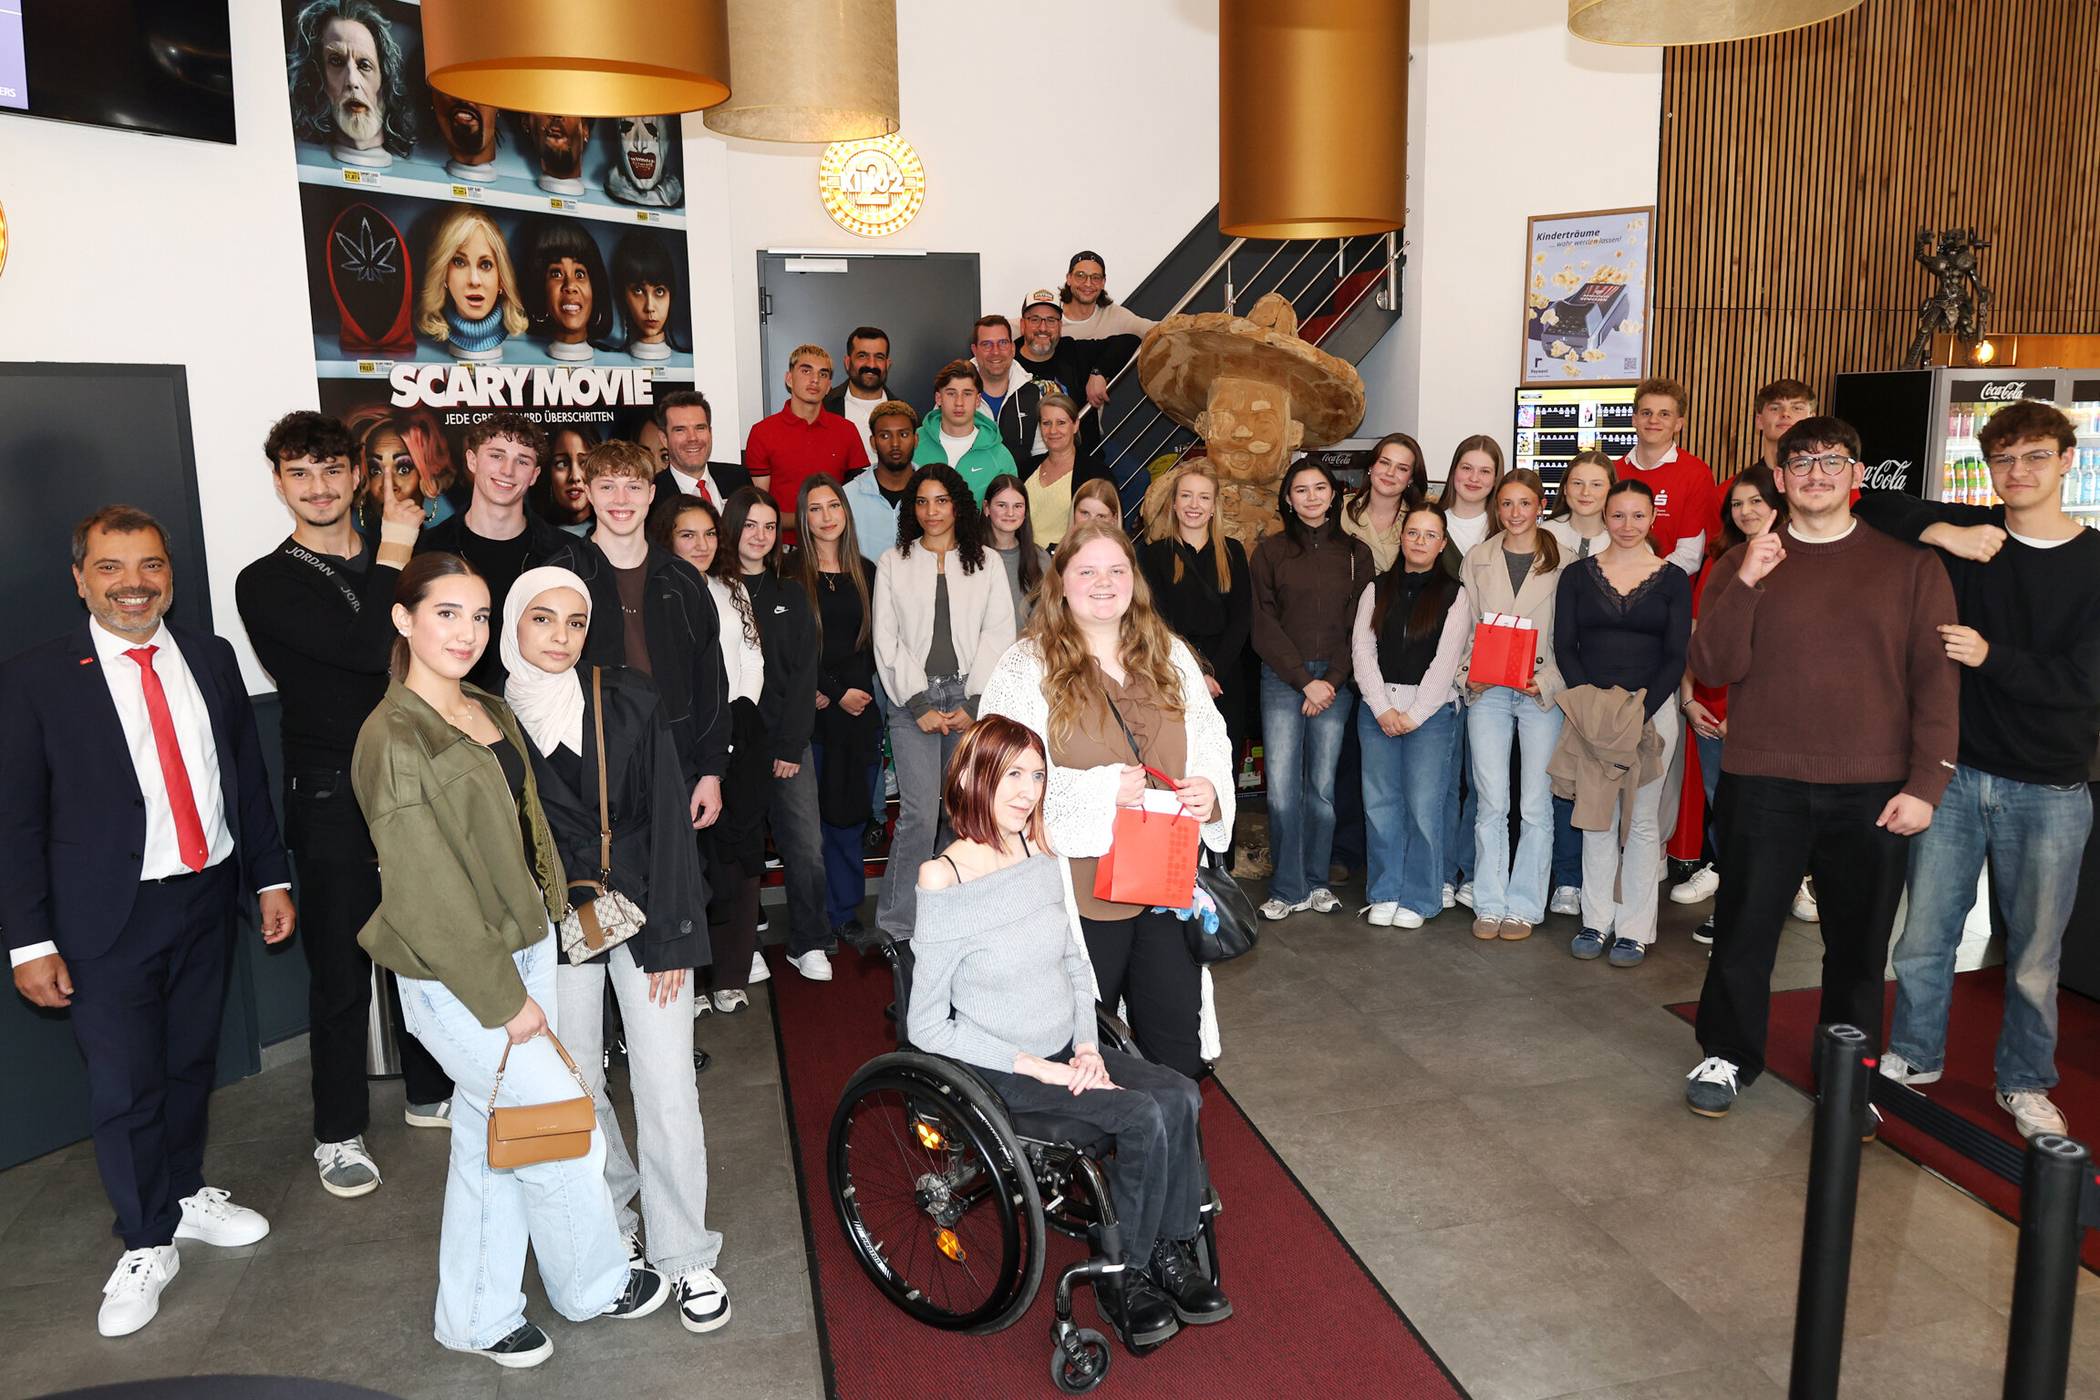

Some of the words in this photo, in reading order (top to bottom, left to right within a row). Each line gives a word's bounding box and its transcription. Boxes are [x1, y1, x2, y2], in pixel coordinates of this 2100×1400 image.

[1536, 229, 1601, 241] Kinderträume
[389, 364, 532, 409] SCARY
[531, 366, 655, 407] MOVIE
[1980, 381, 2028, 400] Coca-Cola
[444, 413, 470, 425] JEDE
[544, 409, 615, 423] ÜBERSCHRITTEN
[285, 546, 335, 577] JORDAN
